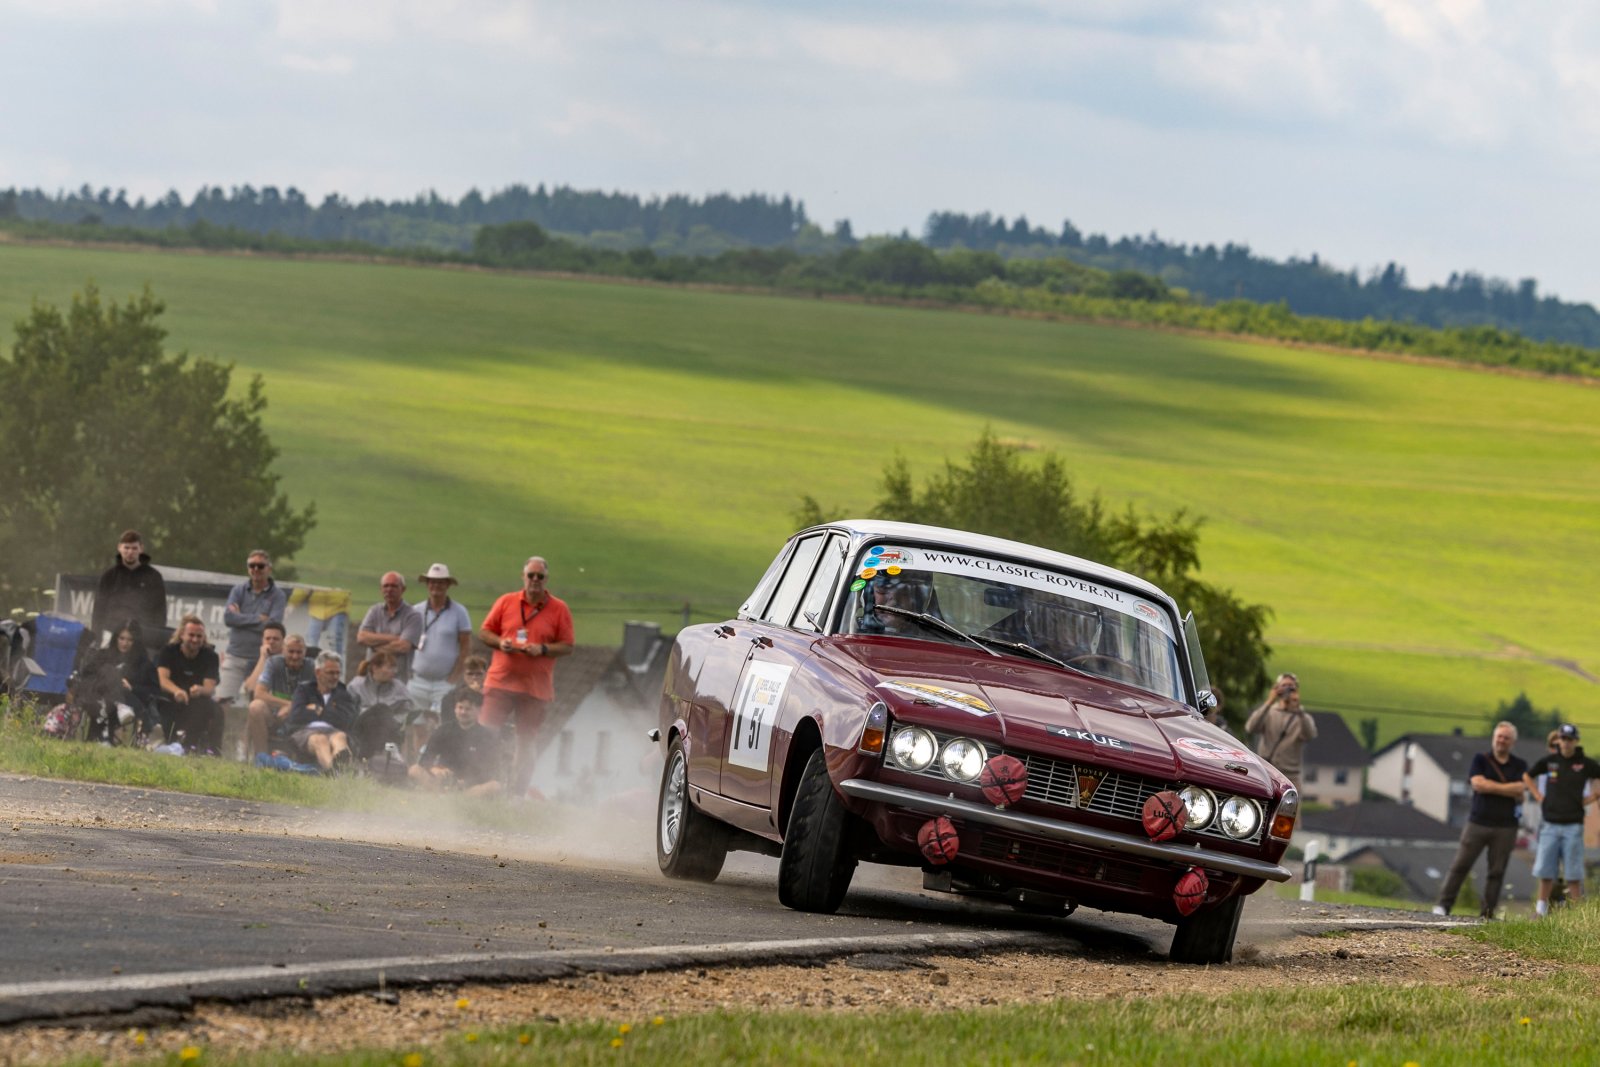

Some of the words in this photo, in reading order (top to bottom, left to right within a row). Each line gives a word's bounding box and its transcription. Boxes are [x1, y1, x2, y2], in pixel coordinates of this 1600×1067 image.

[924, 552, 1124, 603] WWW.CLASSIC-ROVER.NL
[747, 708, 765, 749] 51
[1057, 728, 1071, 737] 4
[1076, 731, 1123, 749] KUE
[1077, 767, 1103, 777] ROVER
